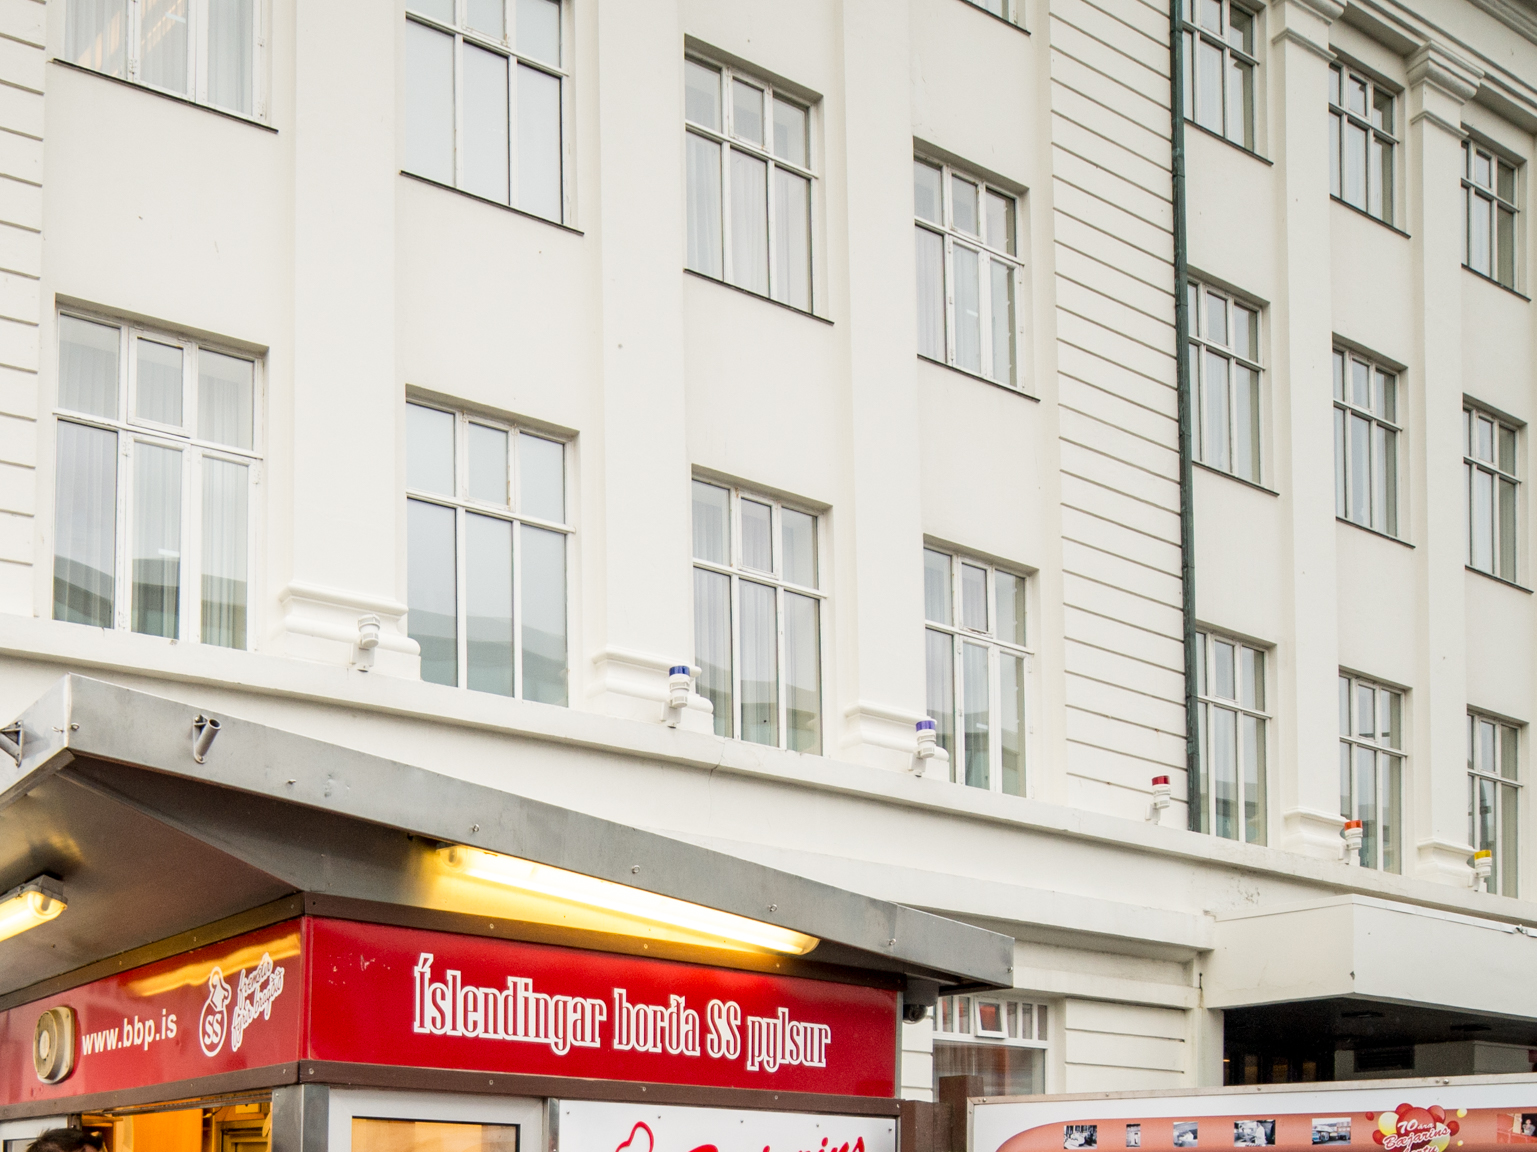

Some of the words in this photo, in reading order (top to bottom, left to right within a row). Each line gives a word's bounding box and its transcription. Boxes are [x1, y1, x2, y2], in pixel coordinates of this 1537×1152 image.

[413, 952, 607, 1056] Íslendingar
[613, 988, 700, 1056] borða
[706, 999, 741, 1060] SS
[746, 1006, 832, 1073] pylsur
[82, 1008, 177, 1055] www.bbp.is
[203, 1013, 222, 1045] SS
[1383, 1126, 1451, 1151] Bæjarins
[1397, 1119, 1418, 1134] 70
